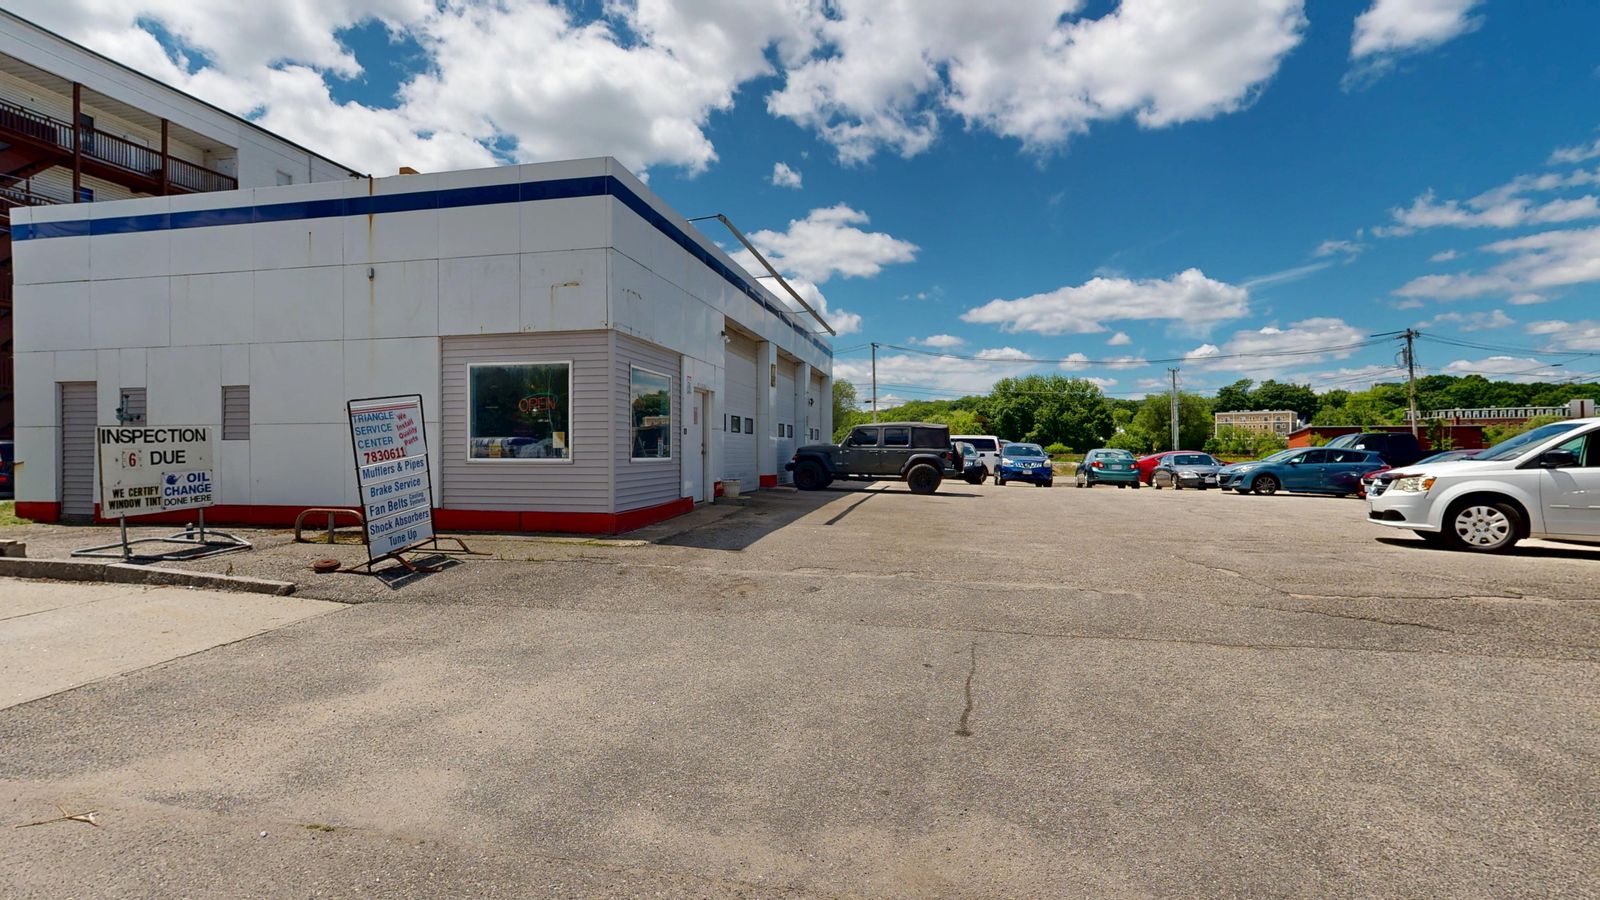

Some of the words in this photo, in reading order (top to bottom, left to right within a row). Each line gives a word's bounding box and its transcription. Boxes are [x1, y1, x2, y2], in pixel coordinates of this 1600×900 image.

[518, 396, 556, 413] OPEN
[351, 411, 394, 423] TRIANGLE
[101, 428, 206, 444] INSPECTION
[355, 423, 393, 436] SERVICE
[357, 436, 394, 449] CENTER
[128, 452, 137, 467] 6
[150, 450, 186, 465] DUE
[363, 447, 406, 464] 7830611
[362, 465, 395, 479] Mufflers
[396, 462, 403, 472] &
[404, 459, 425, 471] Pipes
[186, 472, 210, 483] OIL
[112, 488, 125, 498] WE
[128, 486, 159, 497] CERTIFY
[164, 484, 212, 497] CHANGE
[370, 485, 392, 498] Brake
[394, 477, 421, 492] Service
[108, 498, 141, 510] WINDOW
[145, 496, 162, 507] TINT
[164, 496, 188, 506] DONE
[190, 494, 212, 504] HERE
[369, 504, 386, 517] Fan
[387, 498, 408, 512] Belts
[369, 520, 393, 536] Shock
[395, 510, 429, 527] Absorbers
[389, 533, 406, 547] Tune
[408, 529, 418, 541] Up
